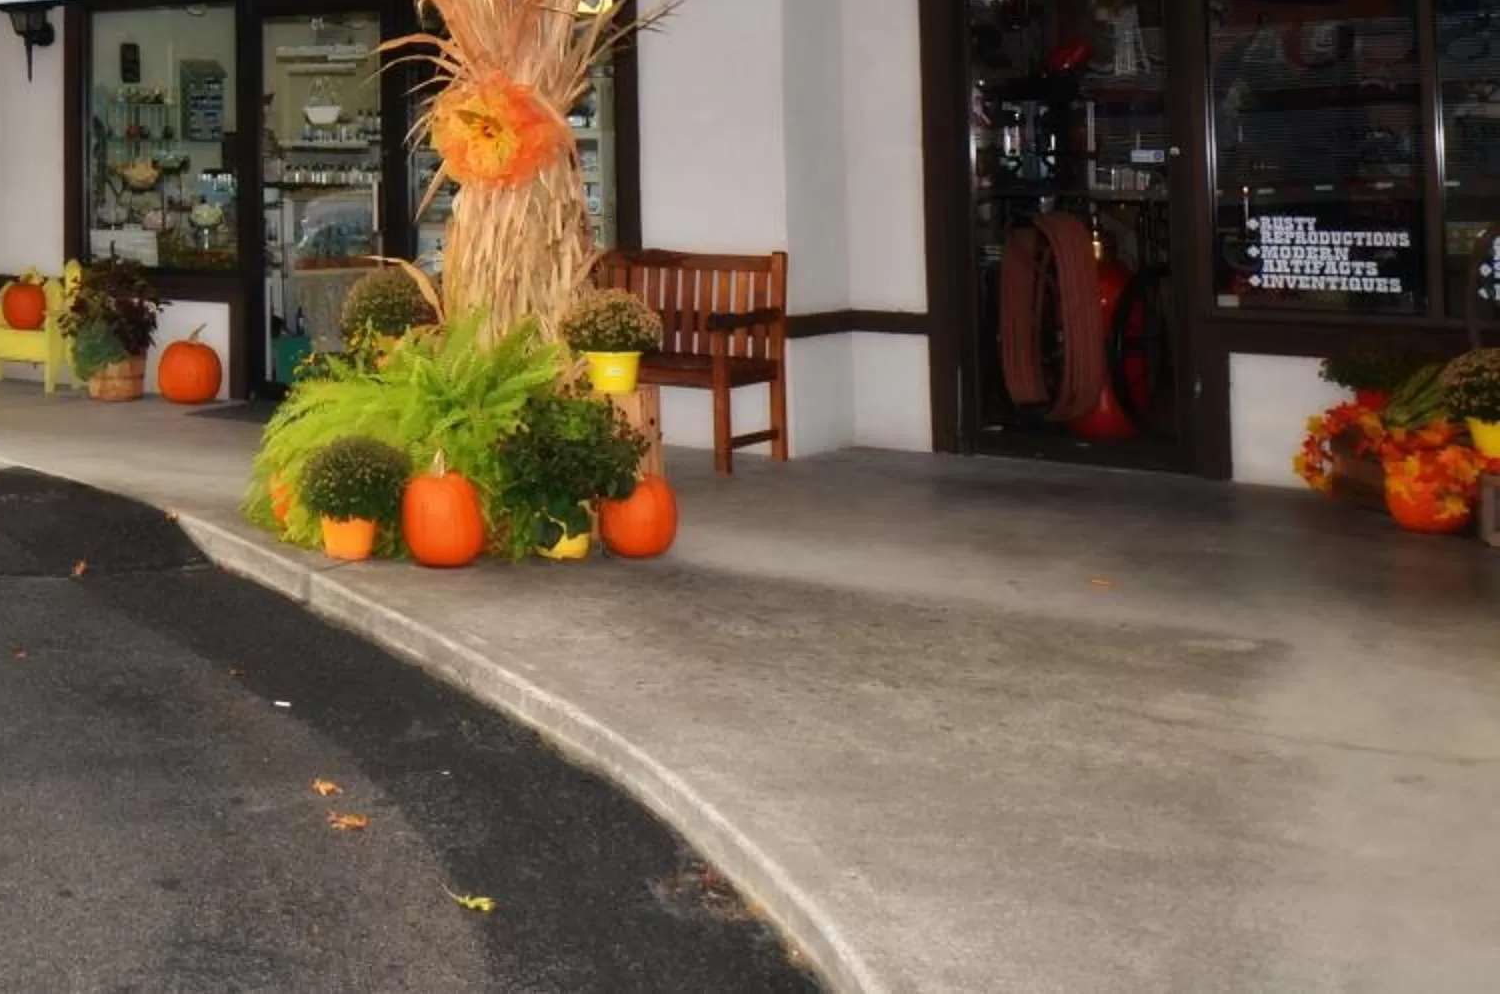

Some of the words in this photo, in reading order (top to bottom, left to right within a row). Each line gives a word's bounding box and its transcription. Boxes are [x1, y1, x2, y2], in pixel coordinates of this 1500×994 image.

[1260, 216, 1316, 231] RUSTY
[1260, 231, 1410, 247] REPRODUCTIONS
[1260, 246, 1349, 261] MODERN
[1262, 260, 1378, 276] ARTIFACTS
[1261, 274, 1402, 293] INVENTIQUES
